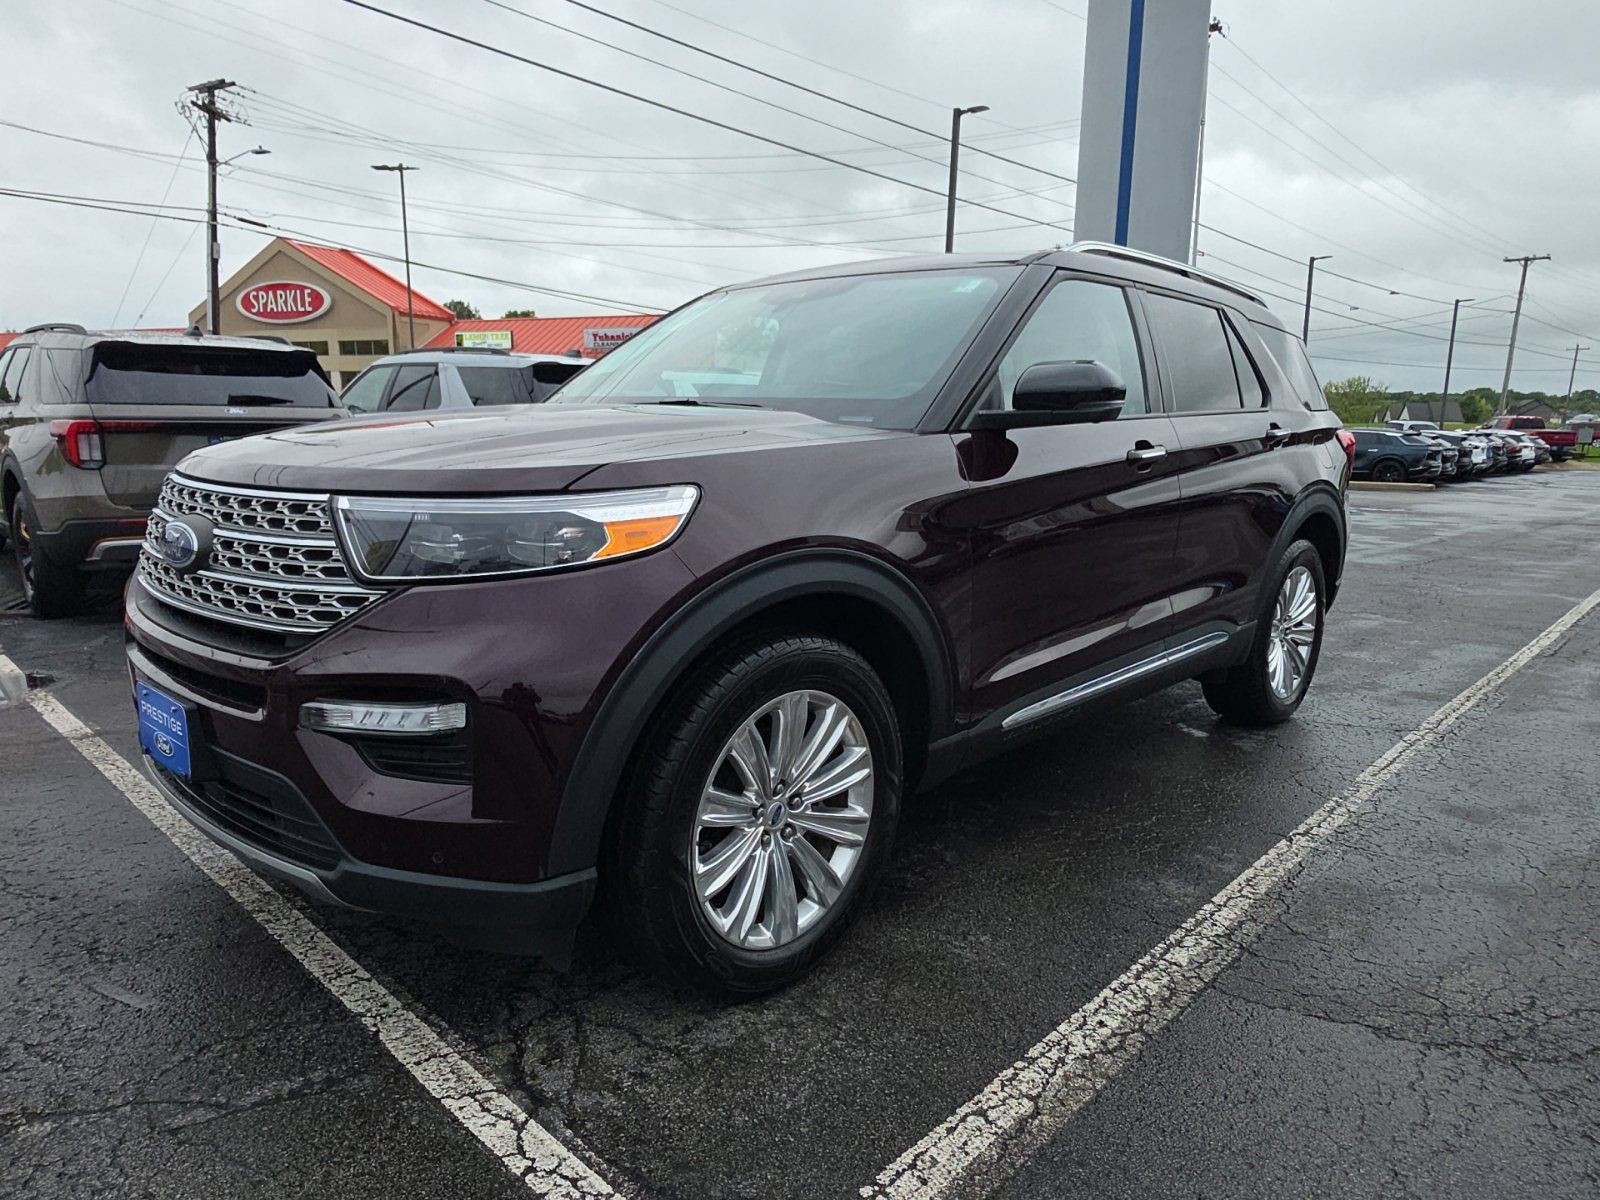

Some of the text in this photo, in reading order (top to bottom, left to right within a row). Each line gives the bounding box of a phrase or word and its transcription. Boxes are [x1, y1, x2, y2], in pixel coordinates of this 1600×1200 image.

[249, 289, 313, 312] SPARKLE
[464, 333, 488, 341] LEMON
[140, 700, 183, 736] PRESTIGE
